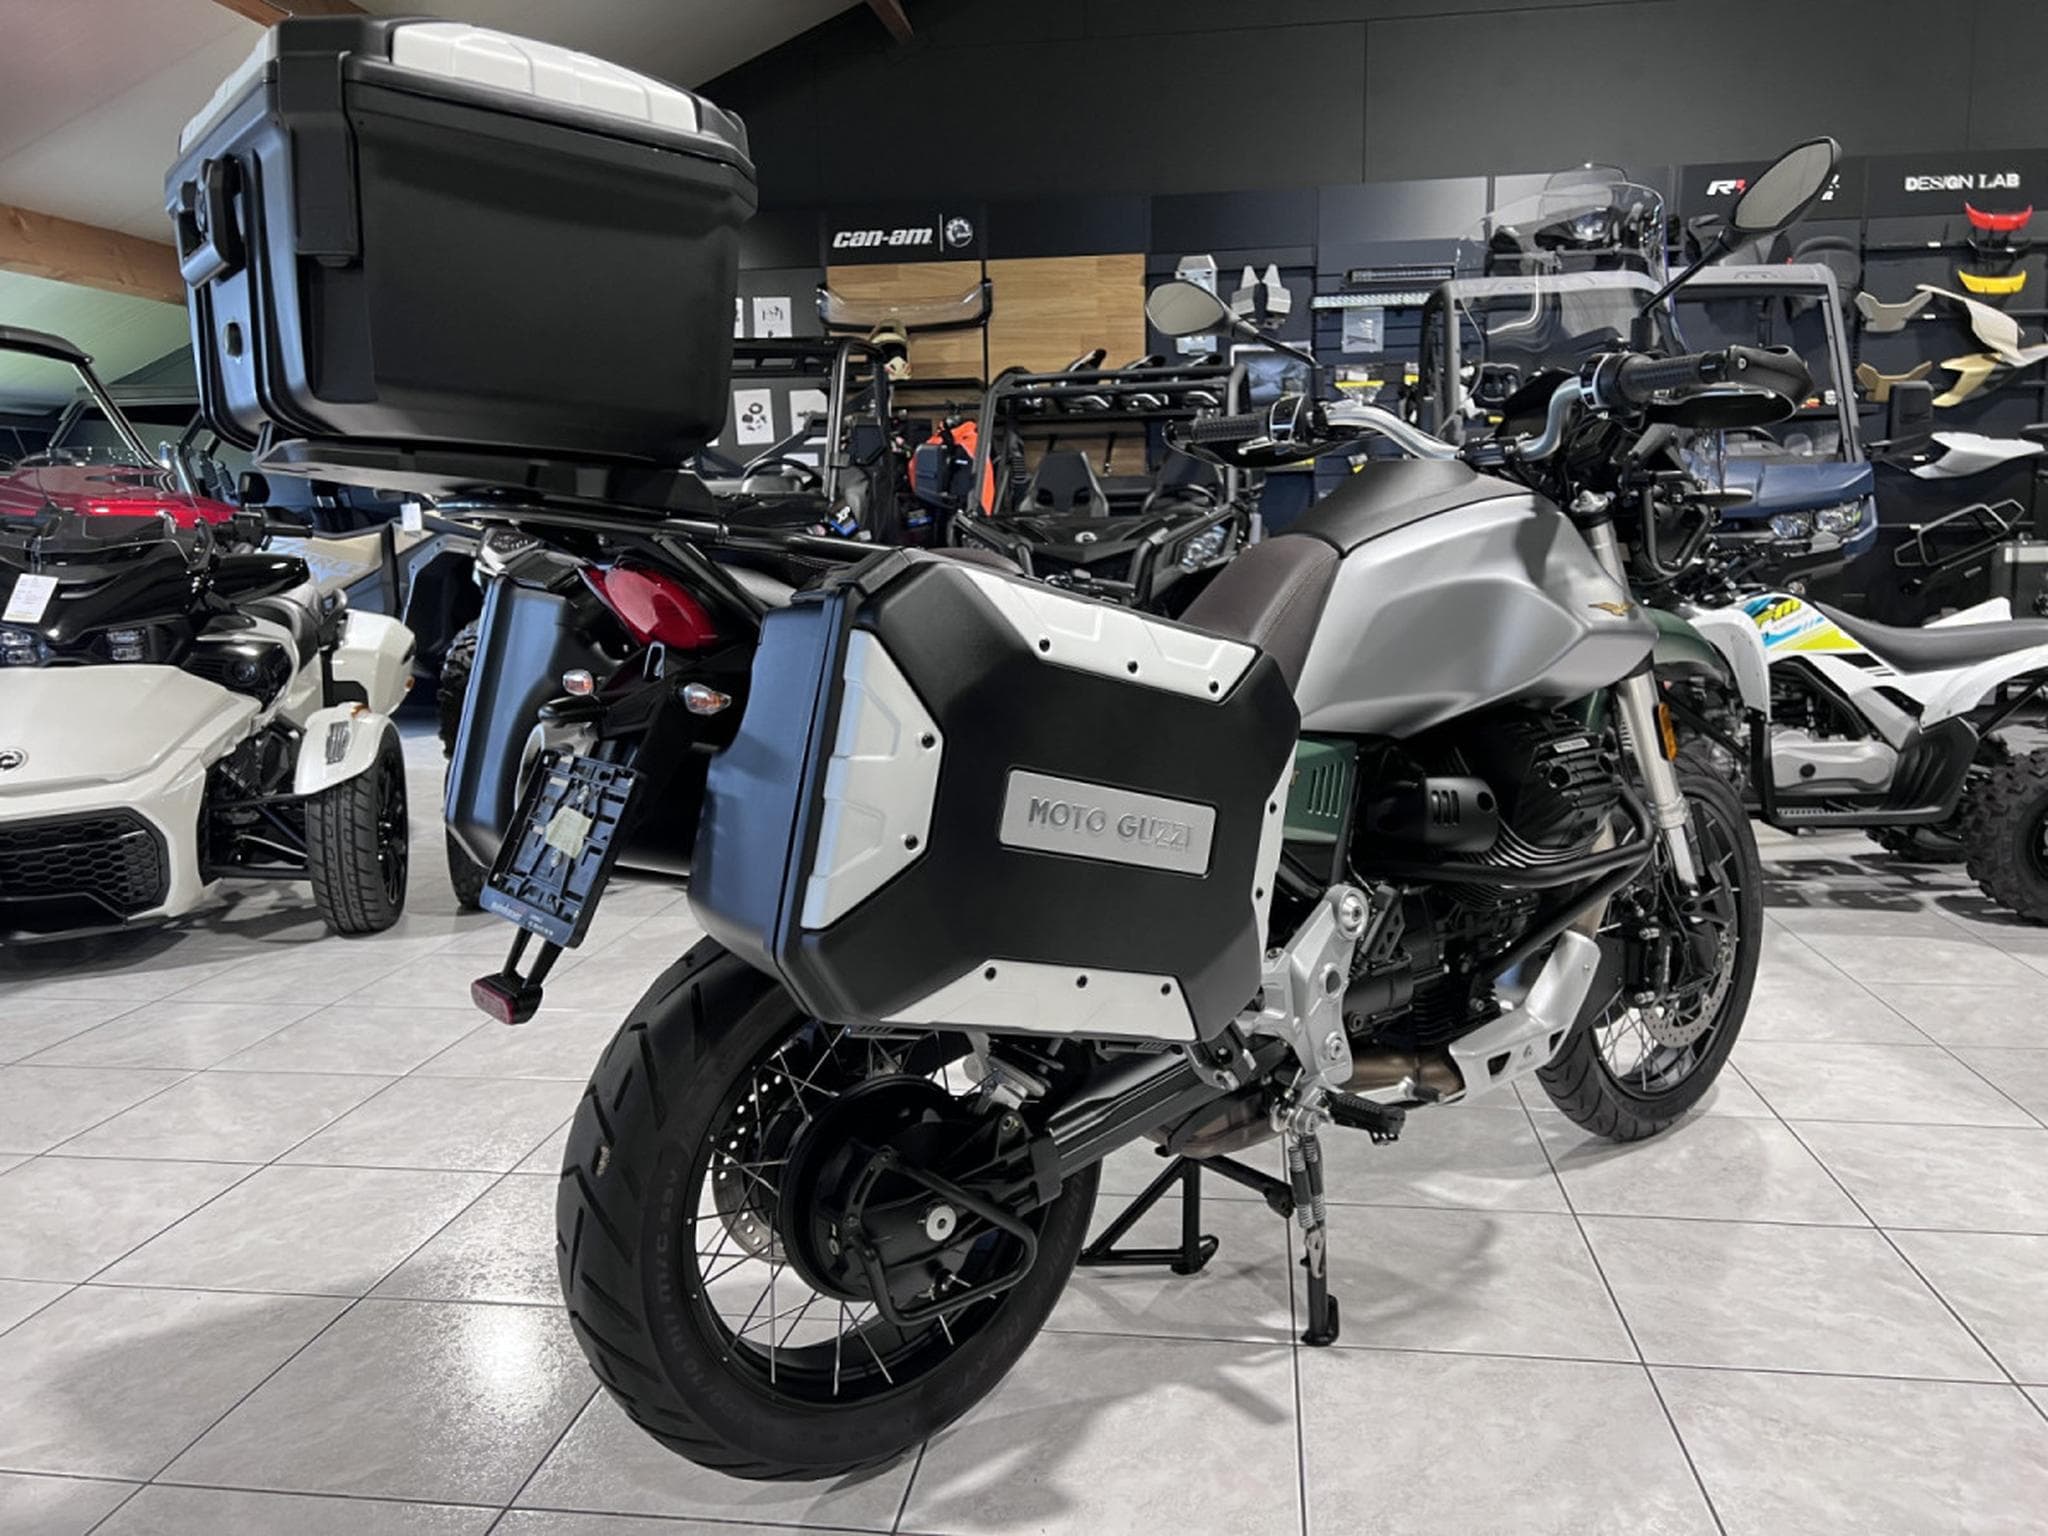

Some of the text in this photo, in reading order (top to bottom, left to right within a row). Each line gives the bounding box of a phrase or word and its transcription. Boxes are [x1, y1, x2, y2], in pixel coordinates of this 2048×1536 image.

[1905, 173, 2020, 191] DESIGN LAB
[832, 228, 932, 248] can-am
[1028, 797, 1191, 850] MOTO GUZZI
